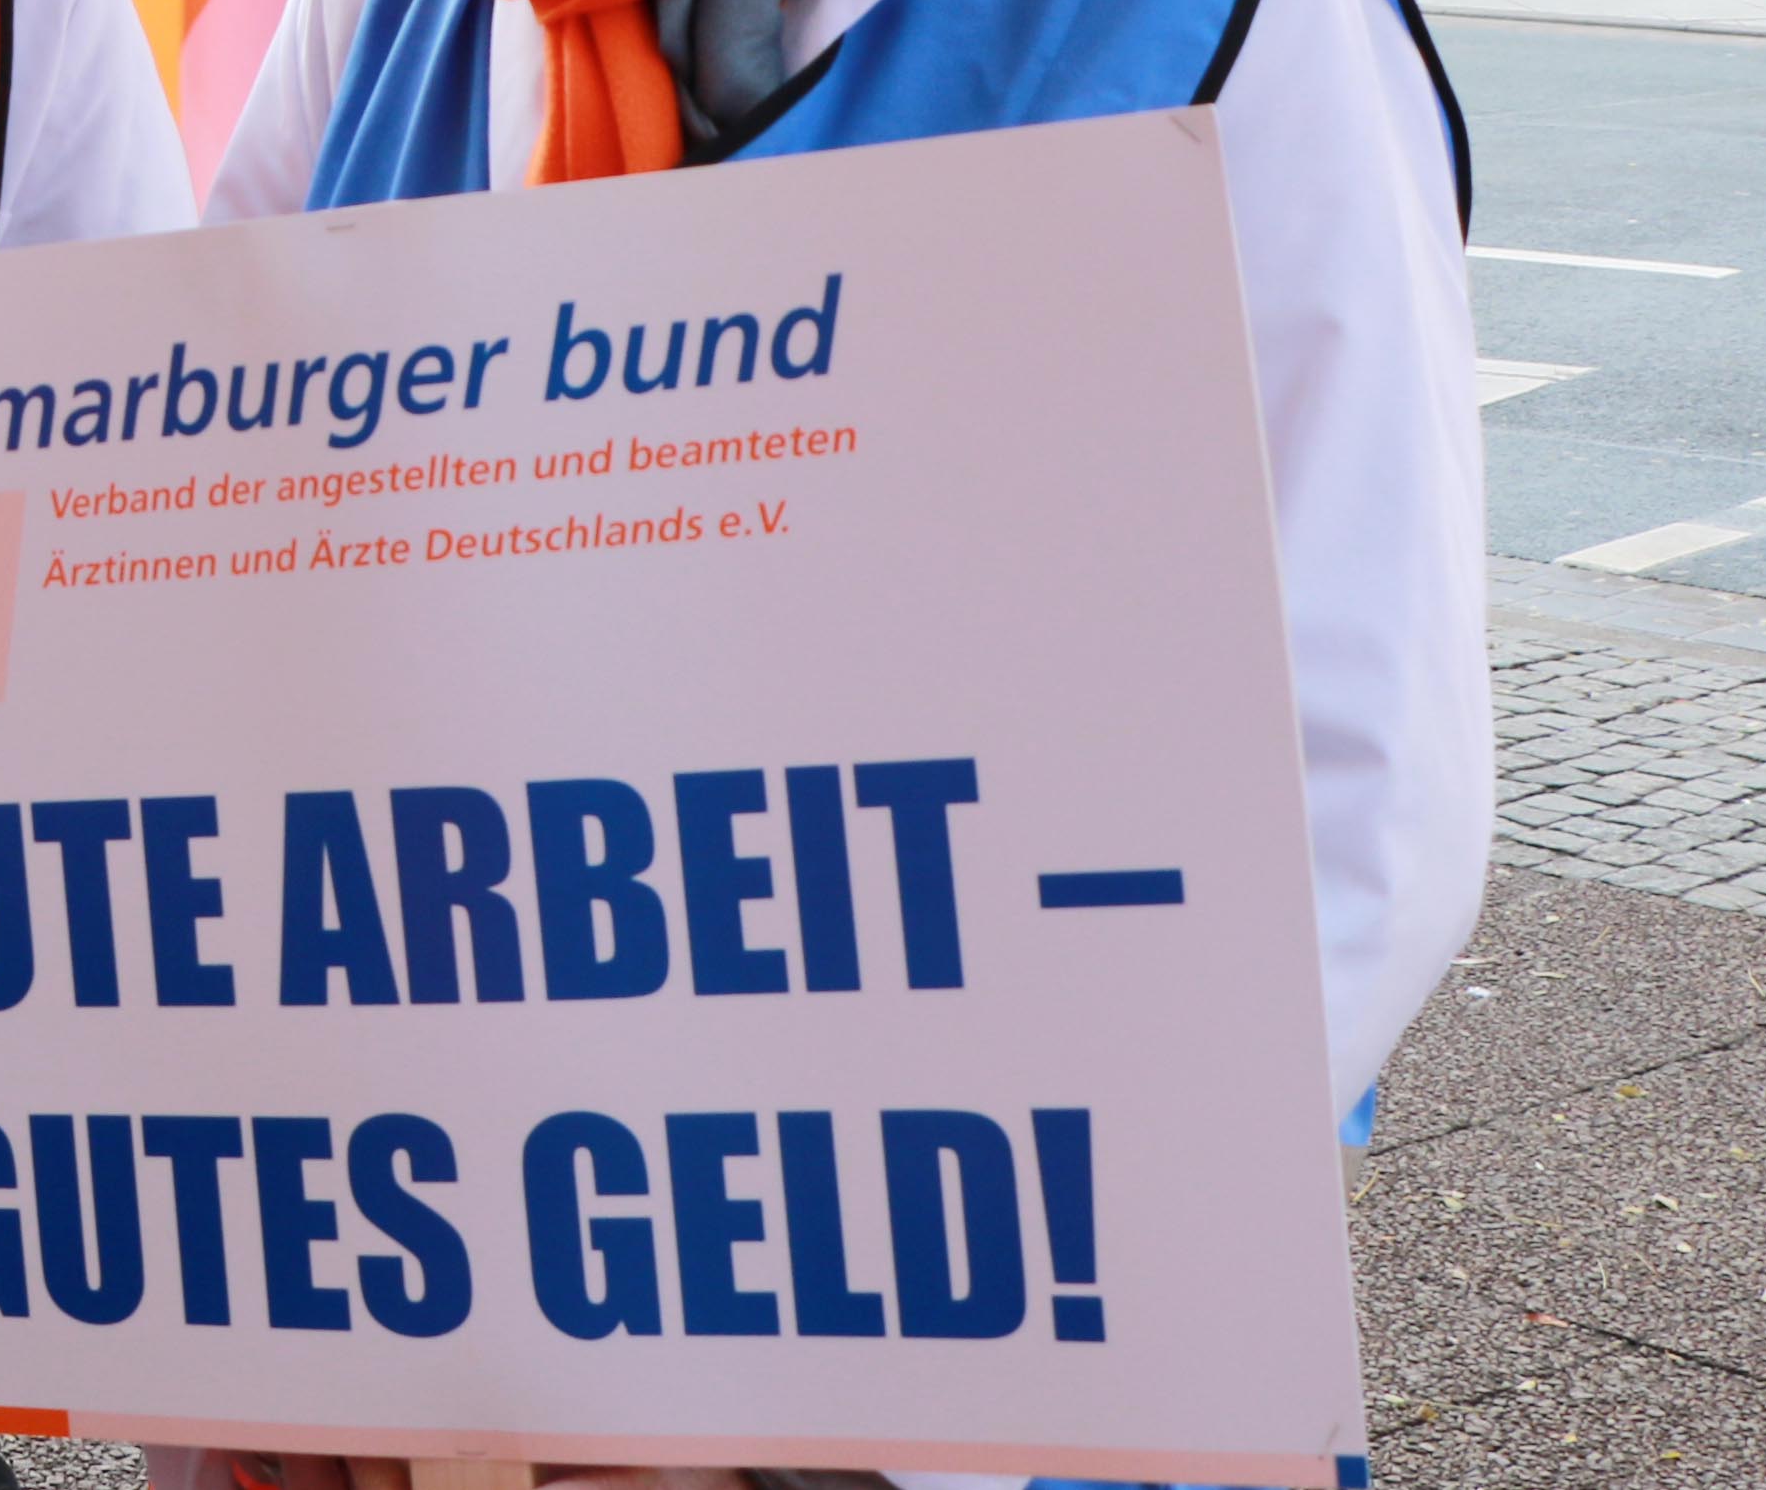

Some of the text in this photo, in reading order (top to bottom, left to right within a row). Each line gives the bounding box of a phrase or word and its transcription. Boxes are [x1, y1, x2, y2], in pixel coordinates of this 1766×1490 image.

[543, 273, 843, 403] bund
[49, 423, 858, 521] Verband der angestellten und beamteten
[43, 500, 791, 589] Ärztinnen und Ärzte Deutschlands e.V.
[278, 757, 980, 1008] ARBEIT
[521, 1105, 1108, 1344] GELD!
